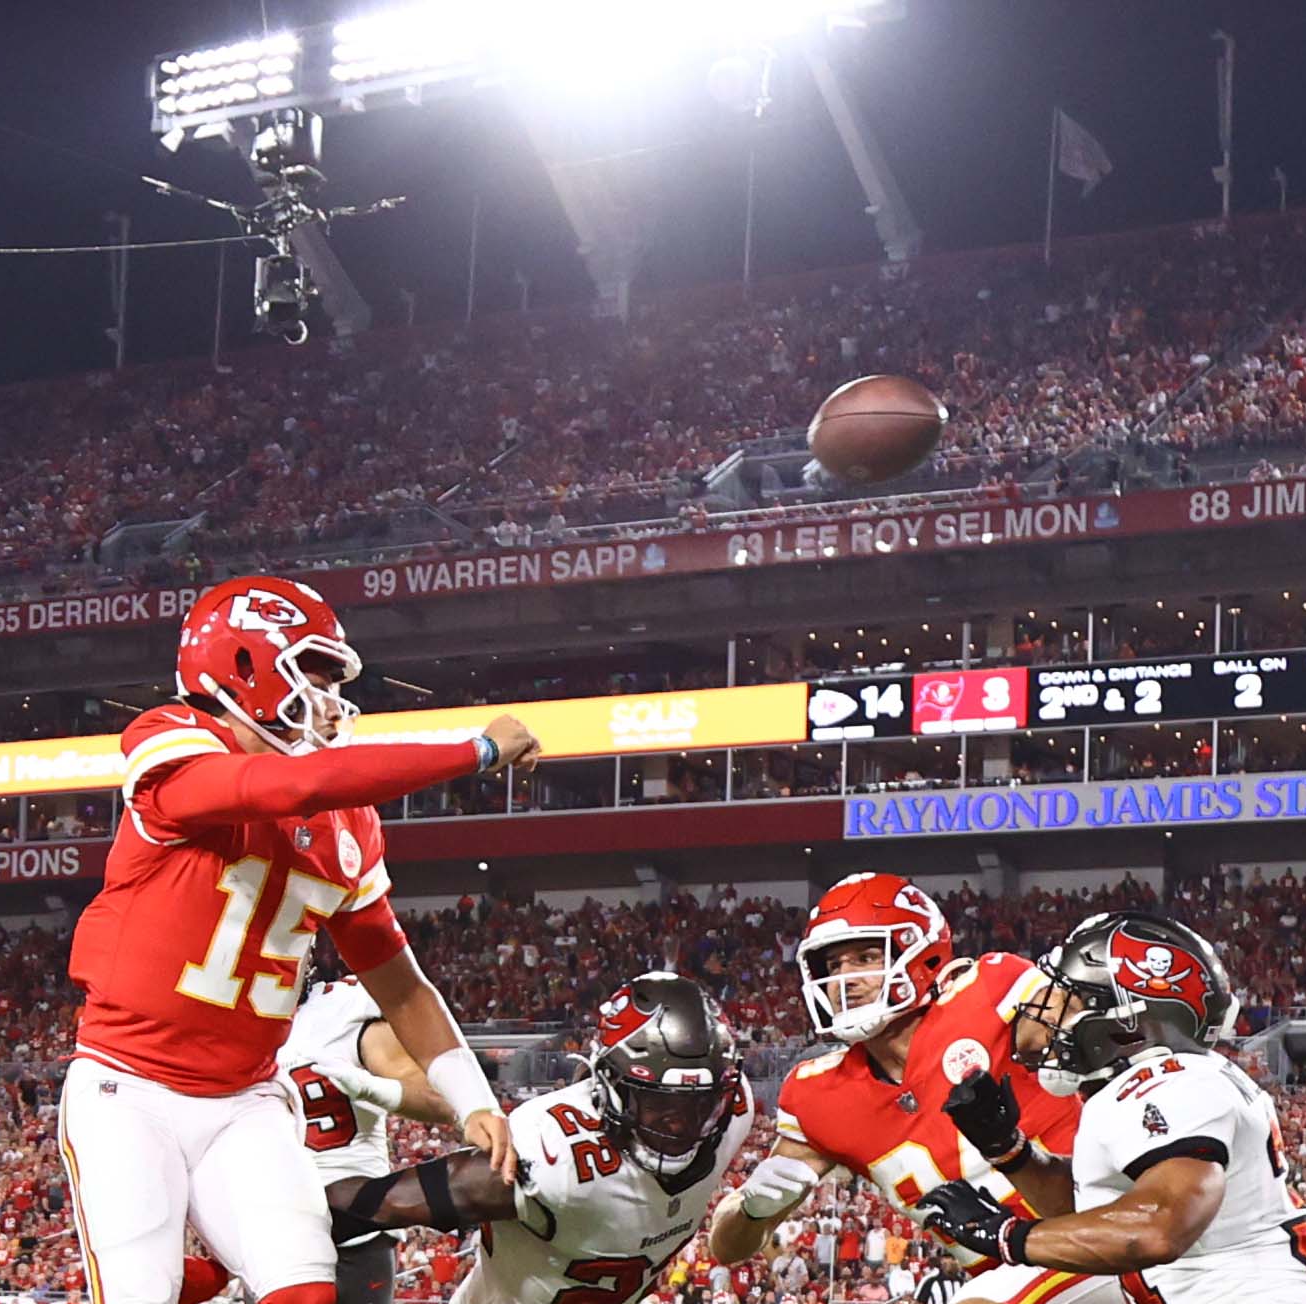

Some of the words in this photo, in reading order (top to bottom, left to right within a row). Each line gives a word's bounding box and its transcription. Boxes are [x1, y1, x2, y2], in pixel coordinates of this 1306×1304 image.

[1189, 490, 1231, 522] 88
[775, 525, 838, 560] LEE
[851, 516, 924, 553] ROY
[934, 502, 1087, 546] SELMON
[363, 569, 396, 598] 99
[405, 553, 541, 593] WARREN
[550, 545, 637, 581] SAPP
[28, 592, 150, 630] DERRICK
[1039, 671, 1089, 686] DOWN
[1108, 663, 1192, 681] DISTANCE
[1213, 660, 1257, 675] BALL
[1260, 656, 1286, 672] ON
[860, 684, 904, 718] 14
[1039, 680, 1098, 720] 2ND
[1104, 689, 1125, 711] &
[1134, 679, 1162, 714] 2
[1234, 674, 1263, 708] 2
[846, 790, 1078, 836] RAYMOND
[1085, 780, 1241, 827] JAMES
[174, 855, 350, 1019] 15
[288, 1062, 358, 1152] 9
